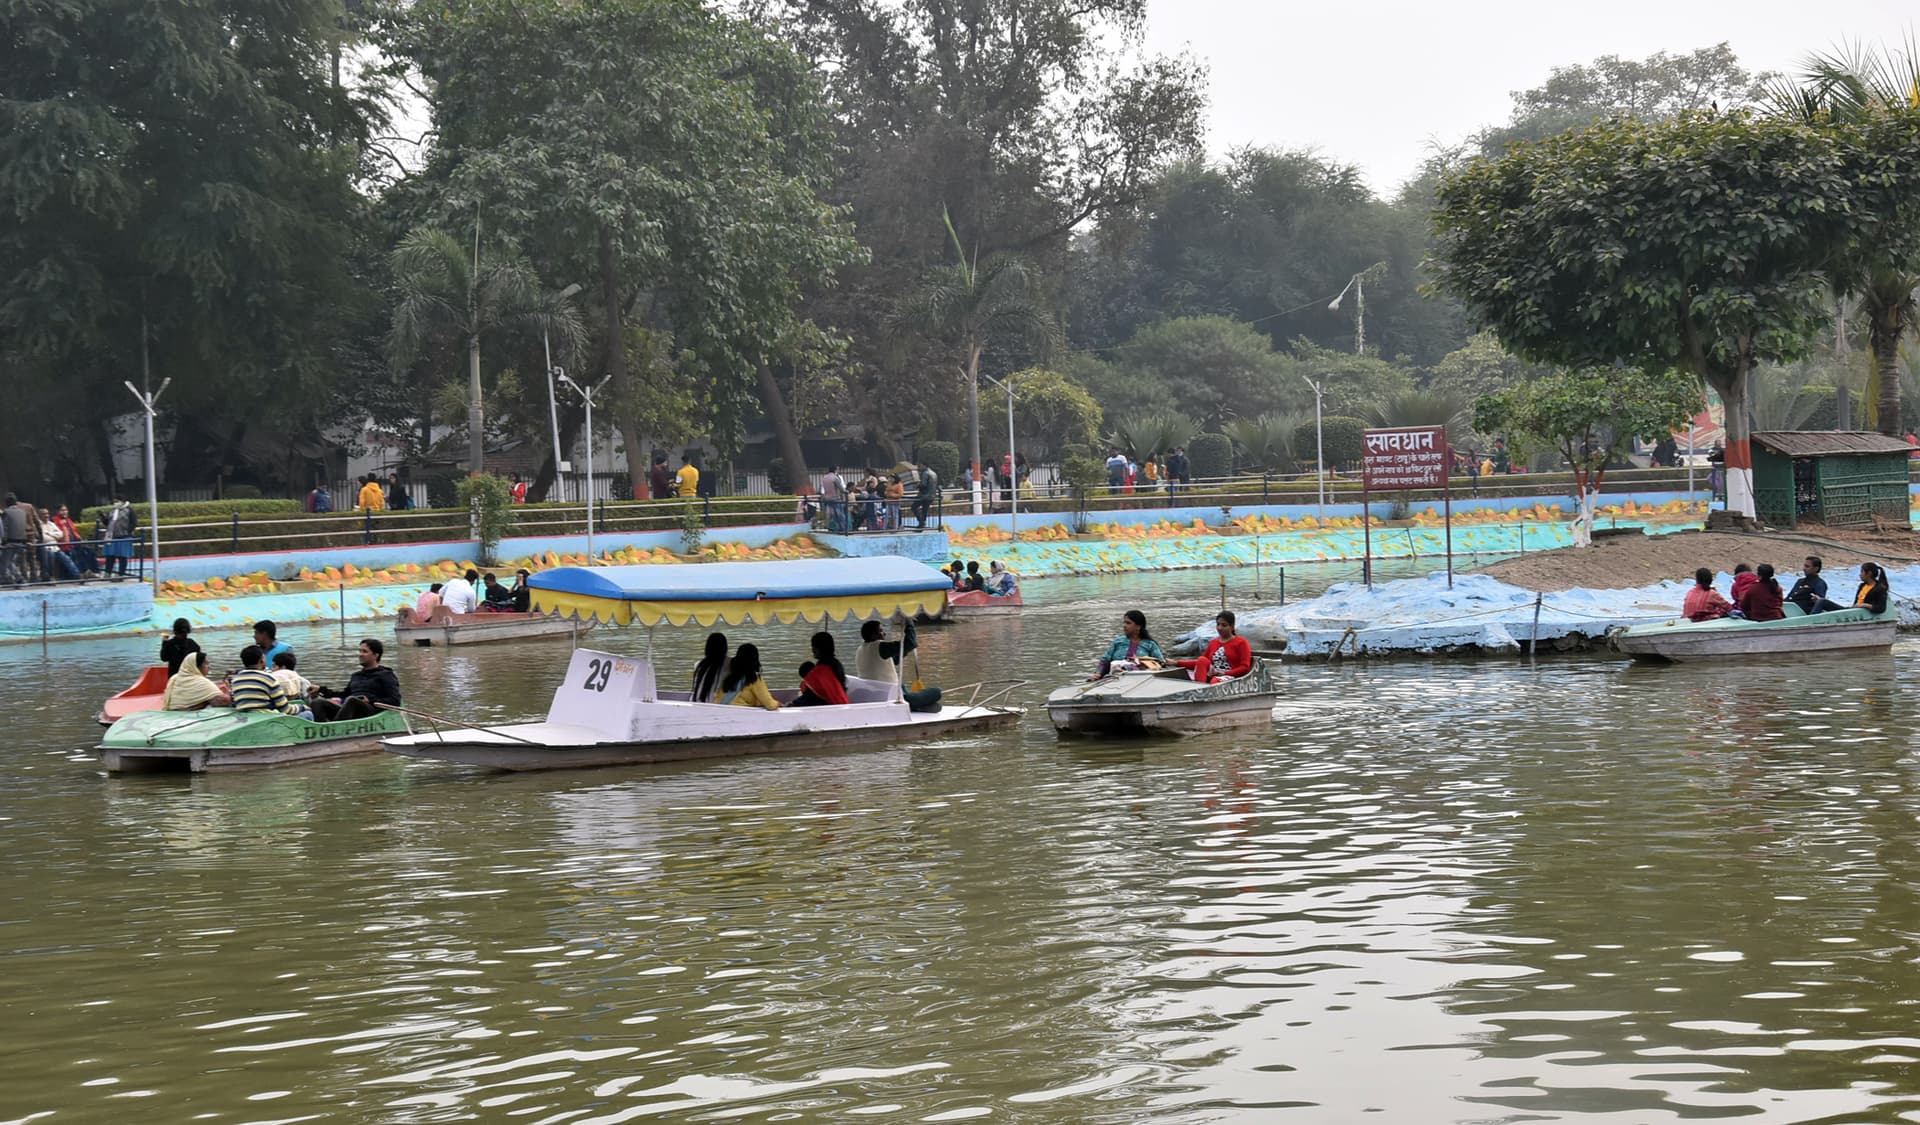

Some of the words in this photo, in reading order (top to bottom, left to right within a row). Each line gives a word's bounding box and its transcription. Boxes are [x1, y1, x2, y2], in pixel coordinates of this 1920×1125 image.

[1365, 431, 1435, 454] सावधान
[583, 658, 613, 693] 29
[303, 718, 386, 739] DOLPHIN
